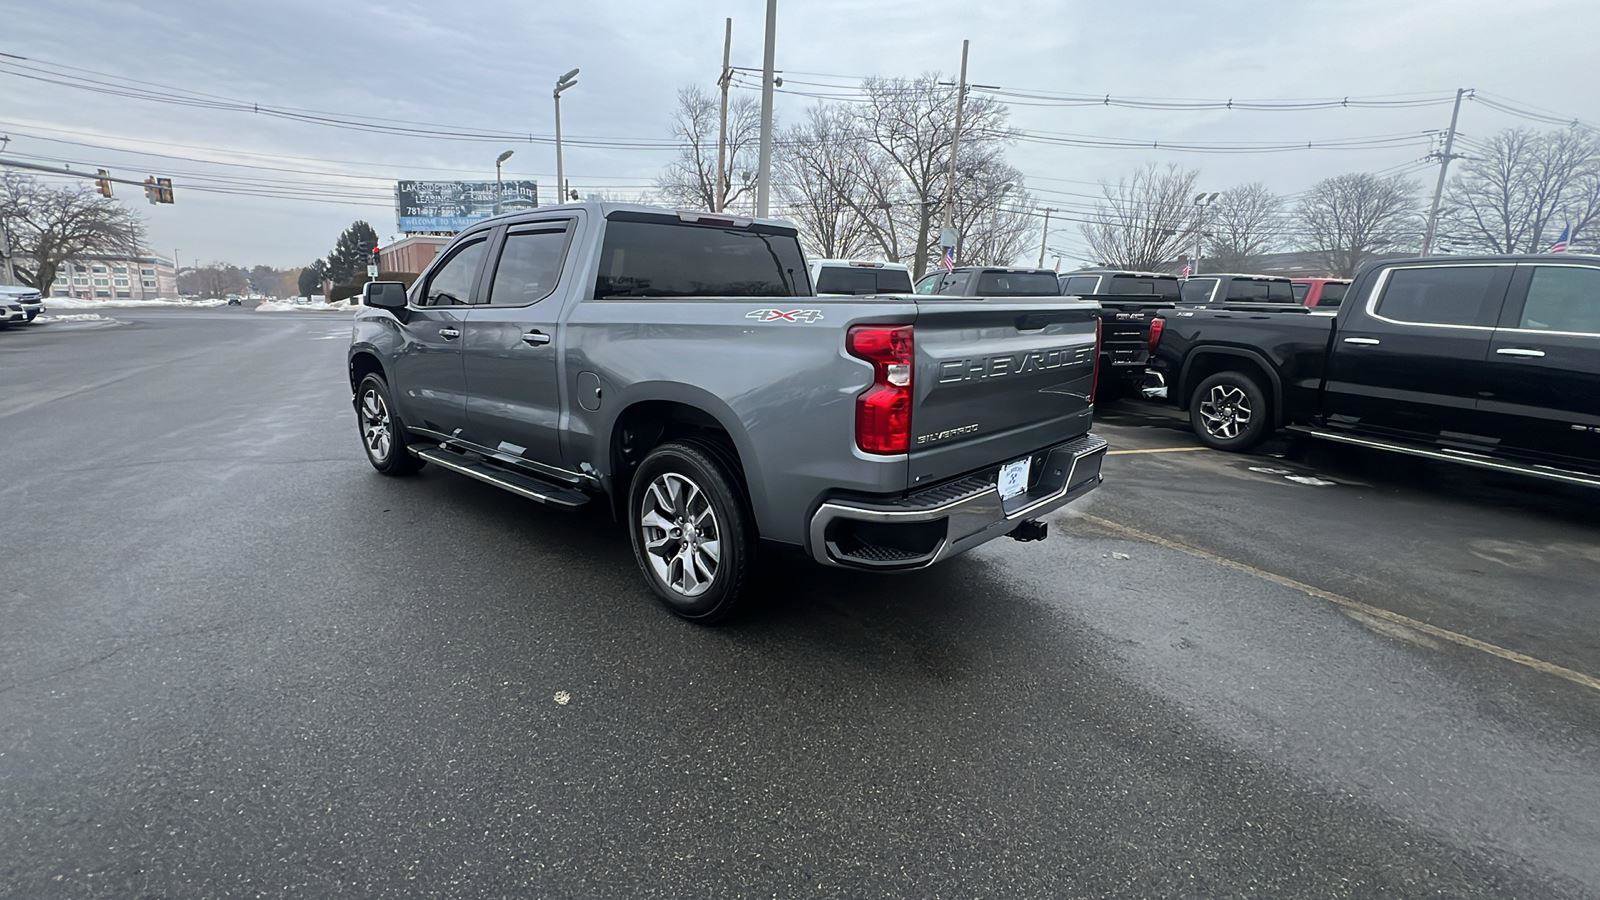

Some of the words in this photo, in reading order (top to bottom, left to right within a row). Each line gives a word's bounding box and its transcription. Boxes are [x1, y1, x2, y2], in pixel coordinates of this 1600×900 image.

[401, 184, 440, 192] LAKESIDE
[441, 184, 464, 192] PARK
[471, 185, 514, 201] Lakesde
[415, 195, 450, 204] LEASING
[938, 346, 1096, 384] CHEVROLET
[917, 423, 979, 444] SILVERADO
